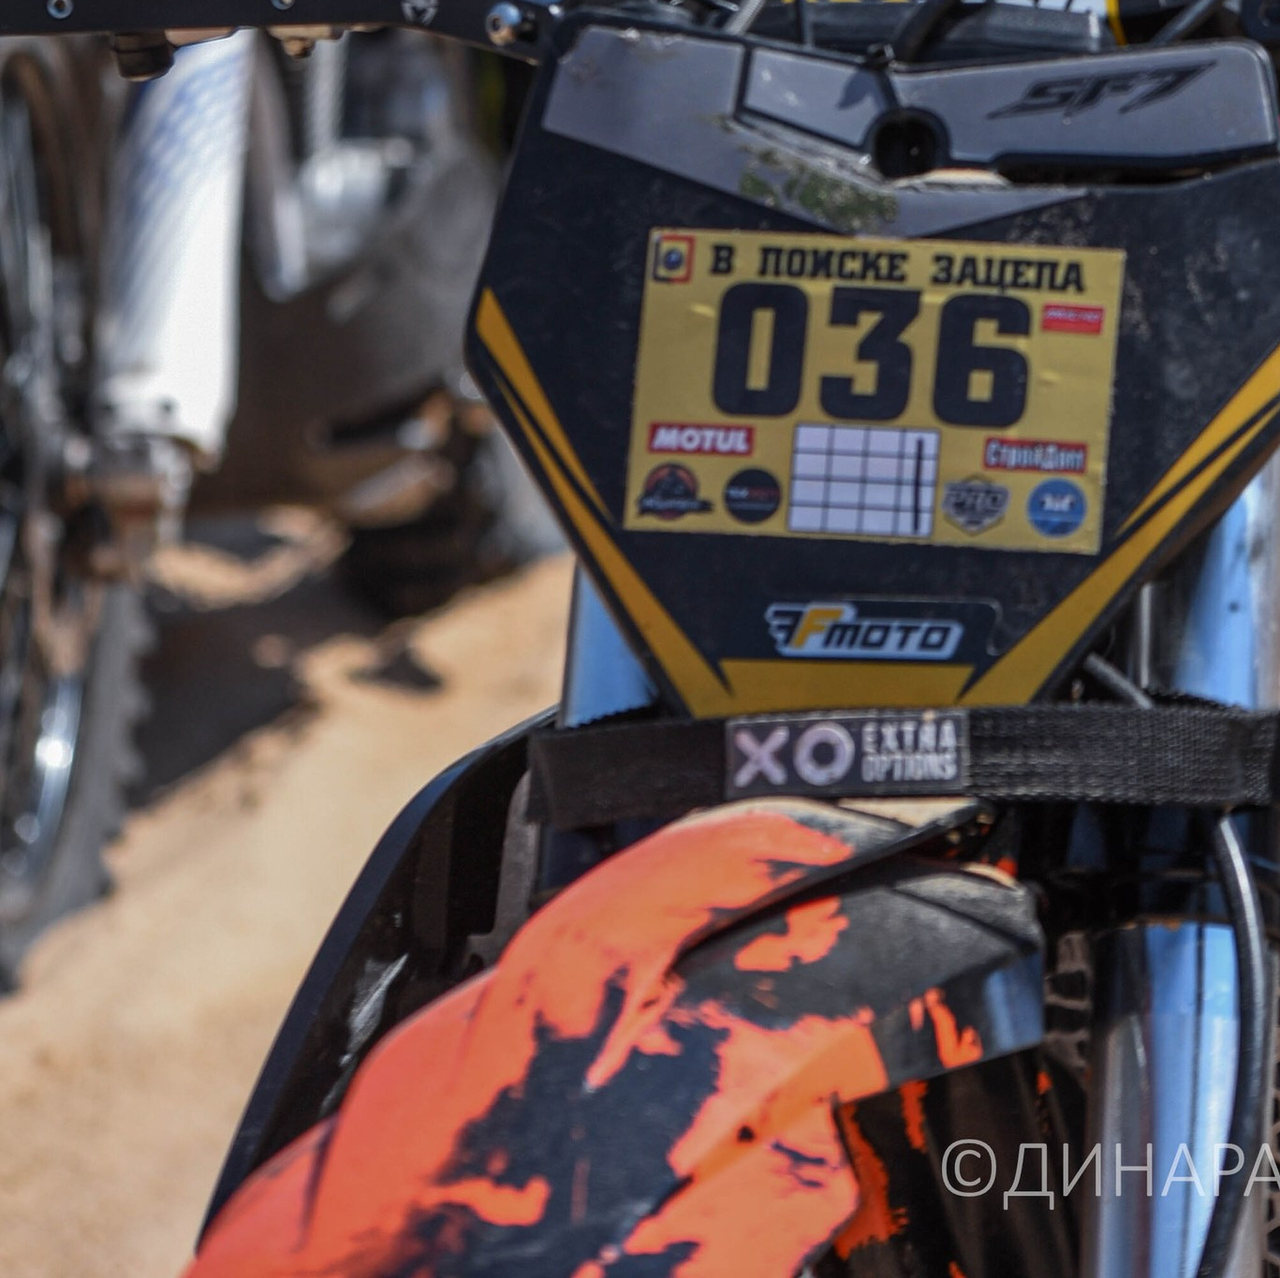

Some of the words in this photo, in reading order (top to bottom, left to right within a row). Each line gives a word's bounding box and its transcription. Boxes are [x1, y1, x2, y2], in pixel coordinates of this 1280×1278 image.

[710, 244, 736, 276] В
[757, 245, 908, 284] ПОИСКЕ
[930, 252, 1086, 295] ЗАЦЕПА
[711, 281, 1032, 429] 036
[652, 425, 750, 455] MOTUL
[733, 721, 855, 787] XO
[861, 722, 957, 755] EXTRA
